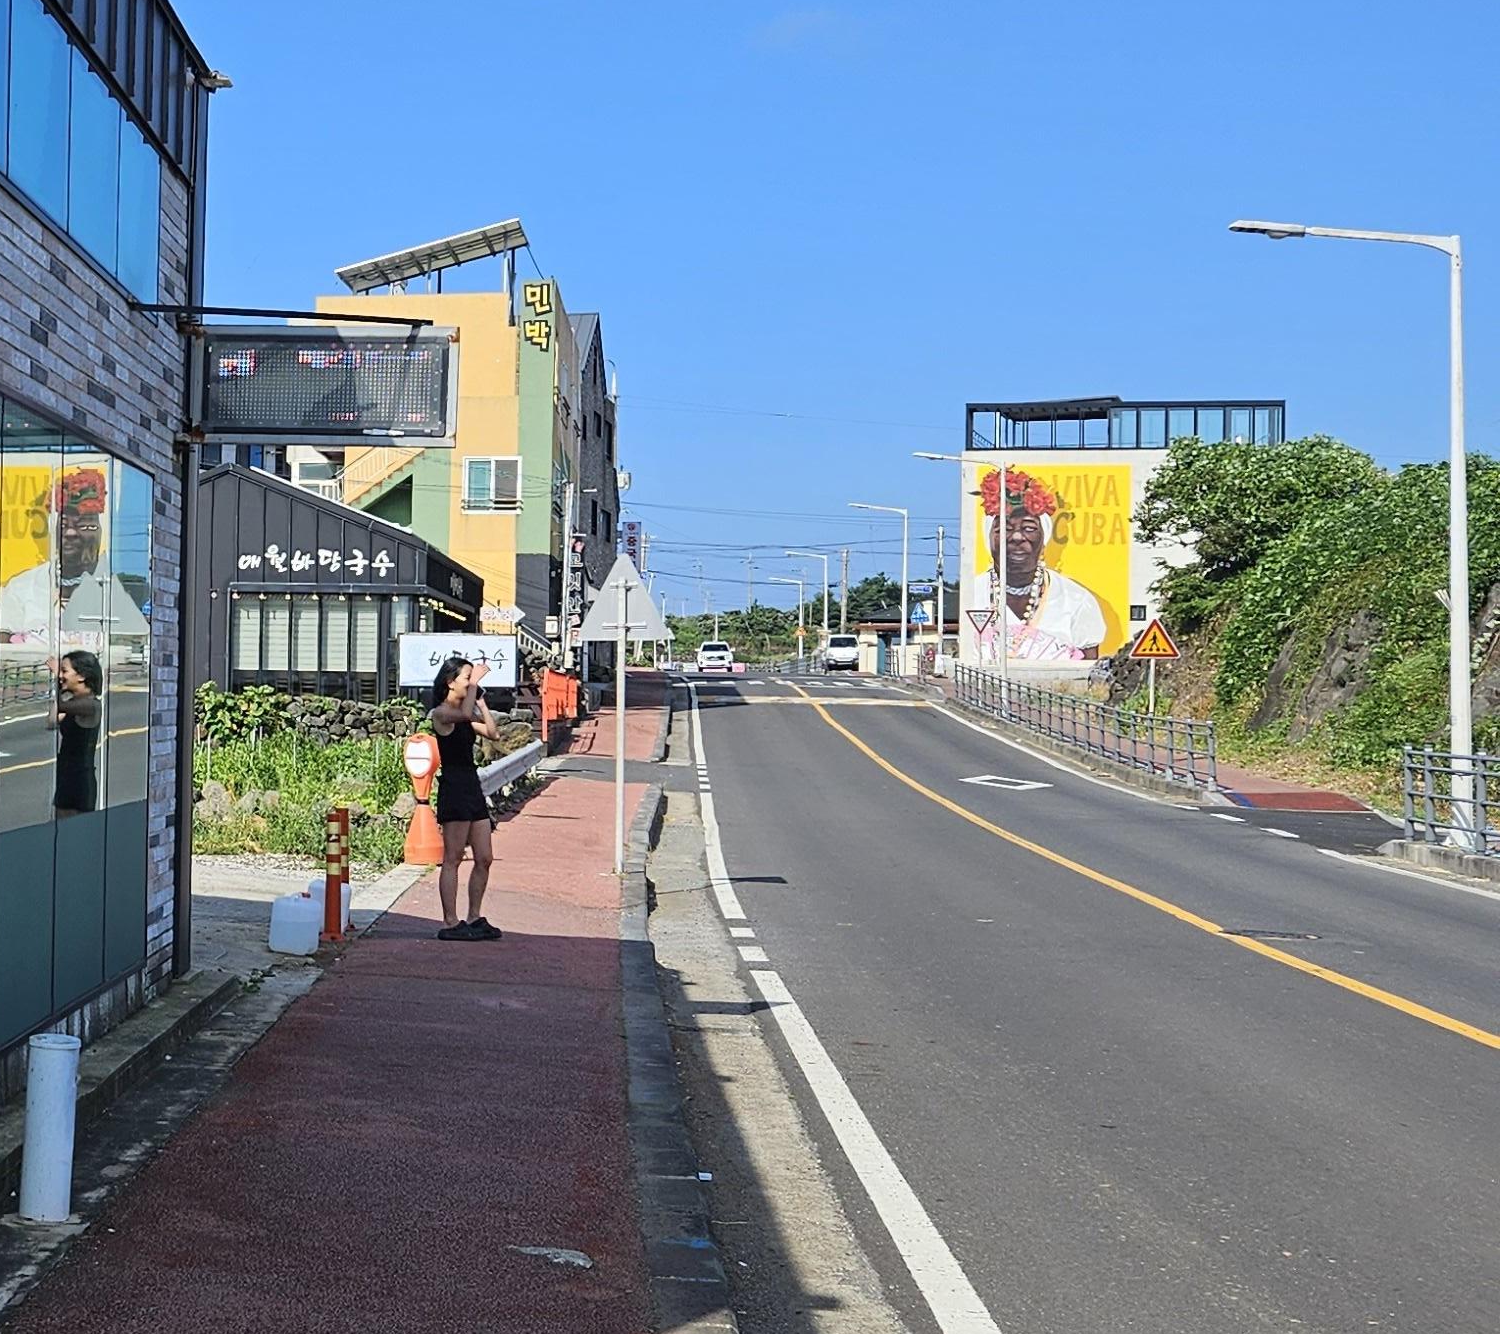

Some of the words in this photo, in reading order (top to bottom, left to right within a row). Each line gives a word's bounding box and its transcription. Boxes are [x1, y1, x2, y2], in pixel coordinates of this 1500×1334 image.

[523, 280, 554, 353] 민박
[1051, 473, 1122, 509] VIVA
[1052, 511, 1129, 547] CUBA
